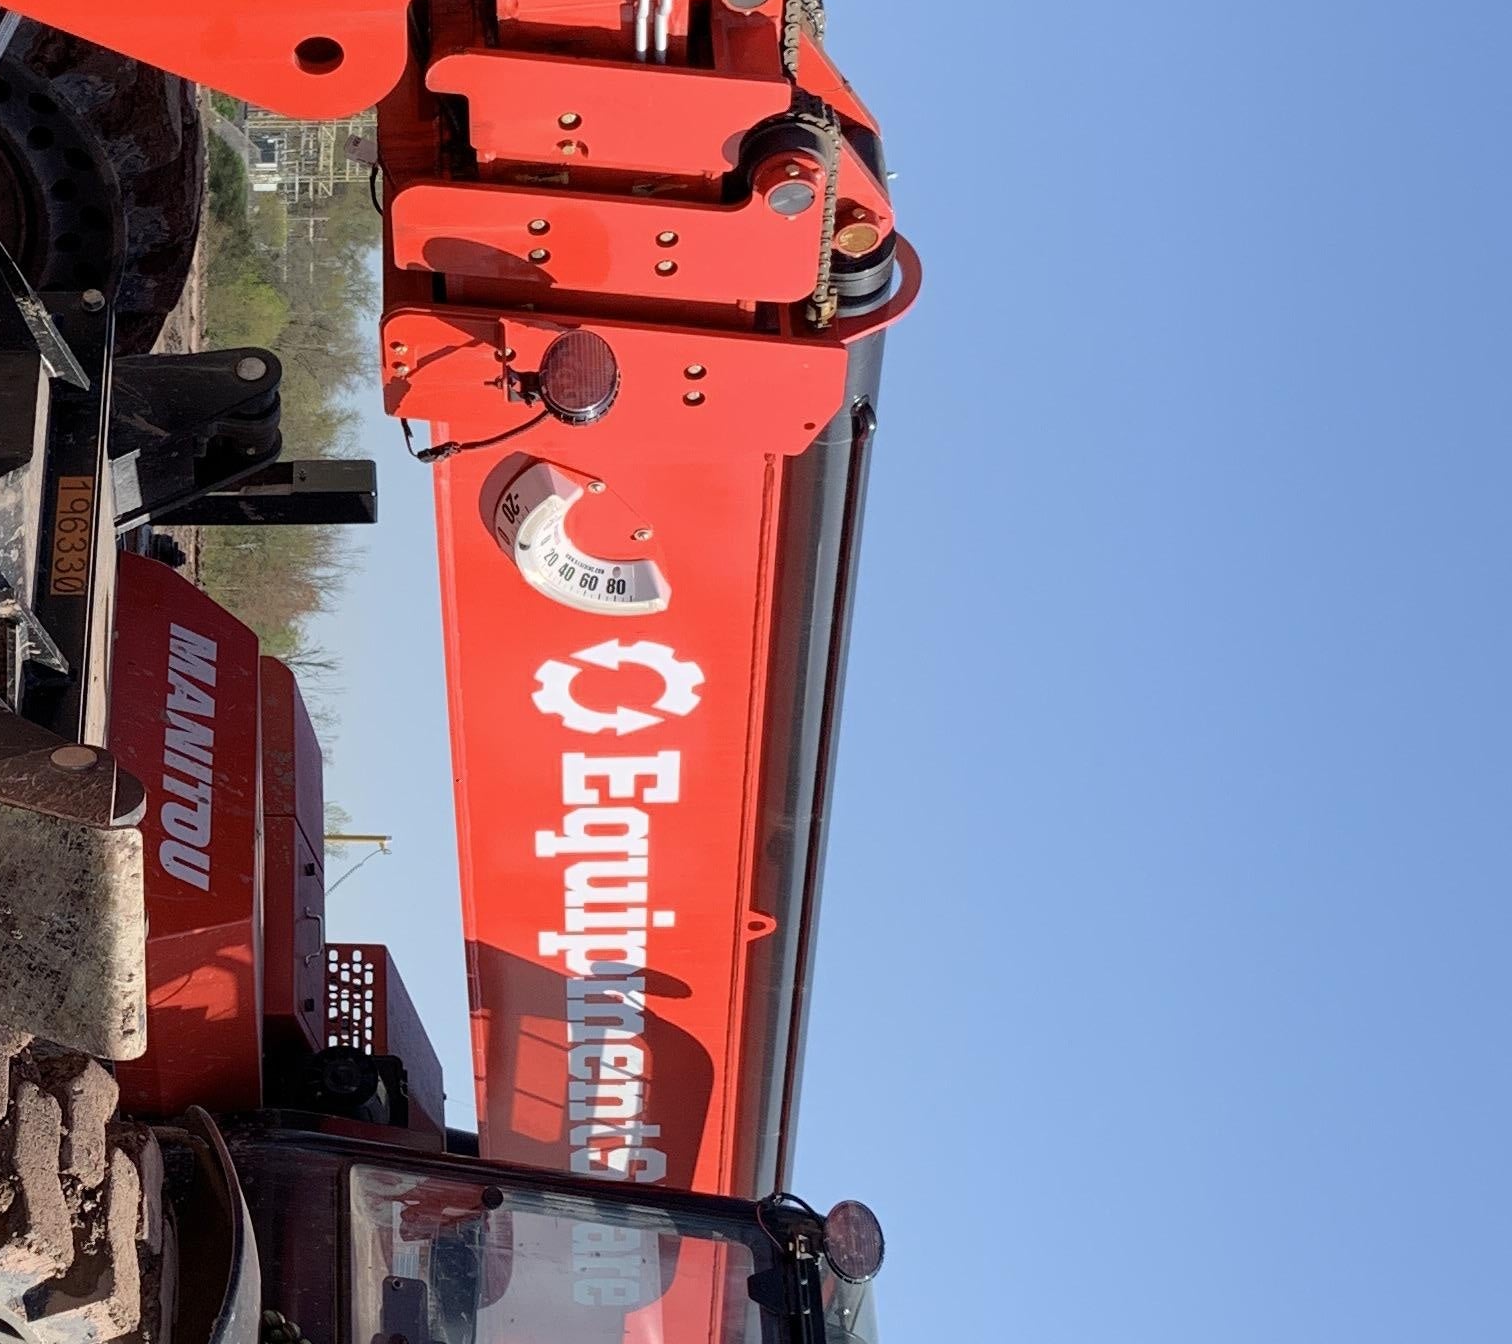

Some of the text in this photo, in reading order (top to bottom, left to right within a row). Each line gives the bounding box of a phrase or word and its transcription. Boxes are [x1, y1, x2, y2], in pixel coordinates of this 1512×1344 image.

[52, 481, 91, 594] 196330
[557, 564, 576, 581] 40
[578, 573, 599, 592] 60
[605, 578, 626, 595] 80
[158, 622, 217, 892] MANITOU
[535, 750, 681, 1307] EquipmentSare
